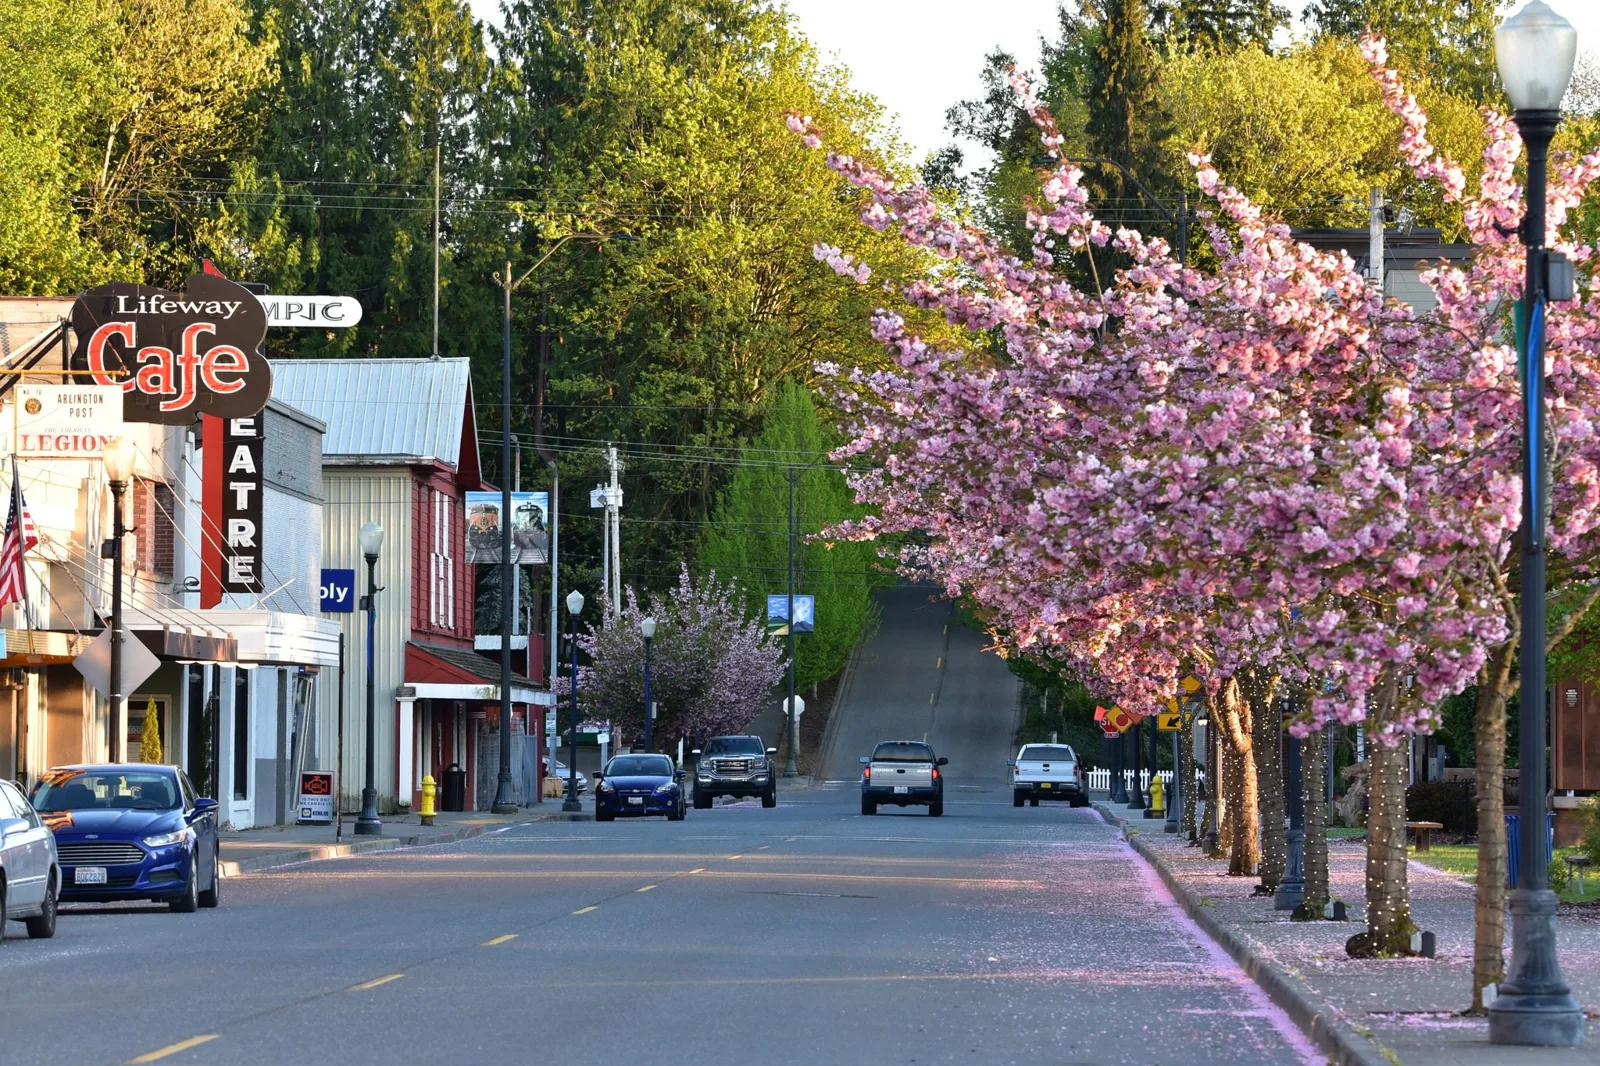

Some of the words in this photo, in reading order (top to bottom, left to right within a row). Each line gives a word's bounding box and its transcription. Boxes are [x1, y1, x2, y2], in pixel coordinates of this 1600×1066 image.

[116, 294, 243, 320] Lifeway
[87, 321, 250, 412] Cafe
[57, 393, 104, 405] ARLINGTON
[69, 407, 93, 418] POST
[20, 435, 113, 452] LEGION
